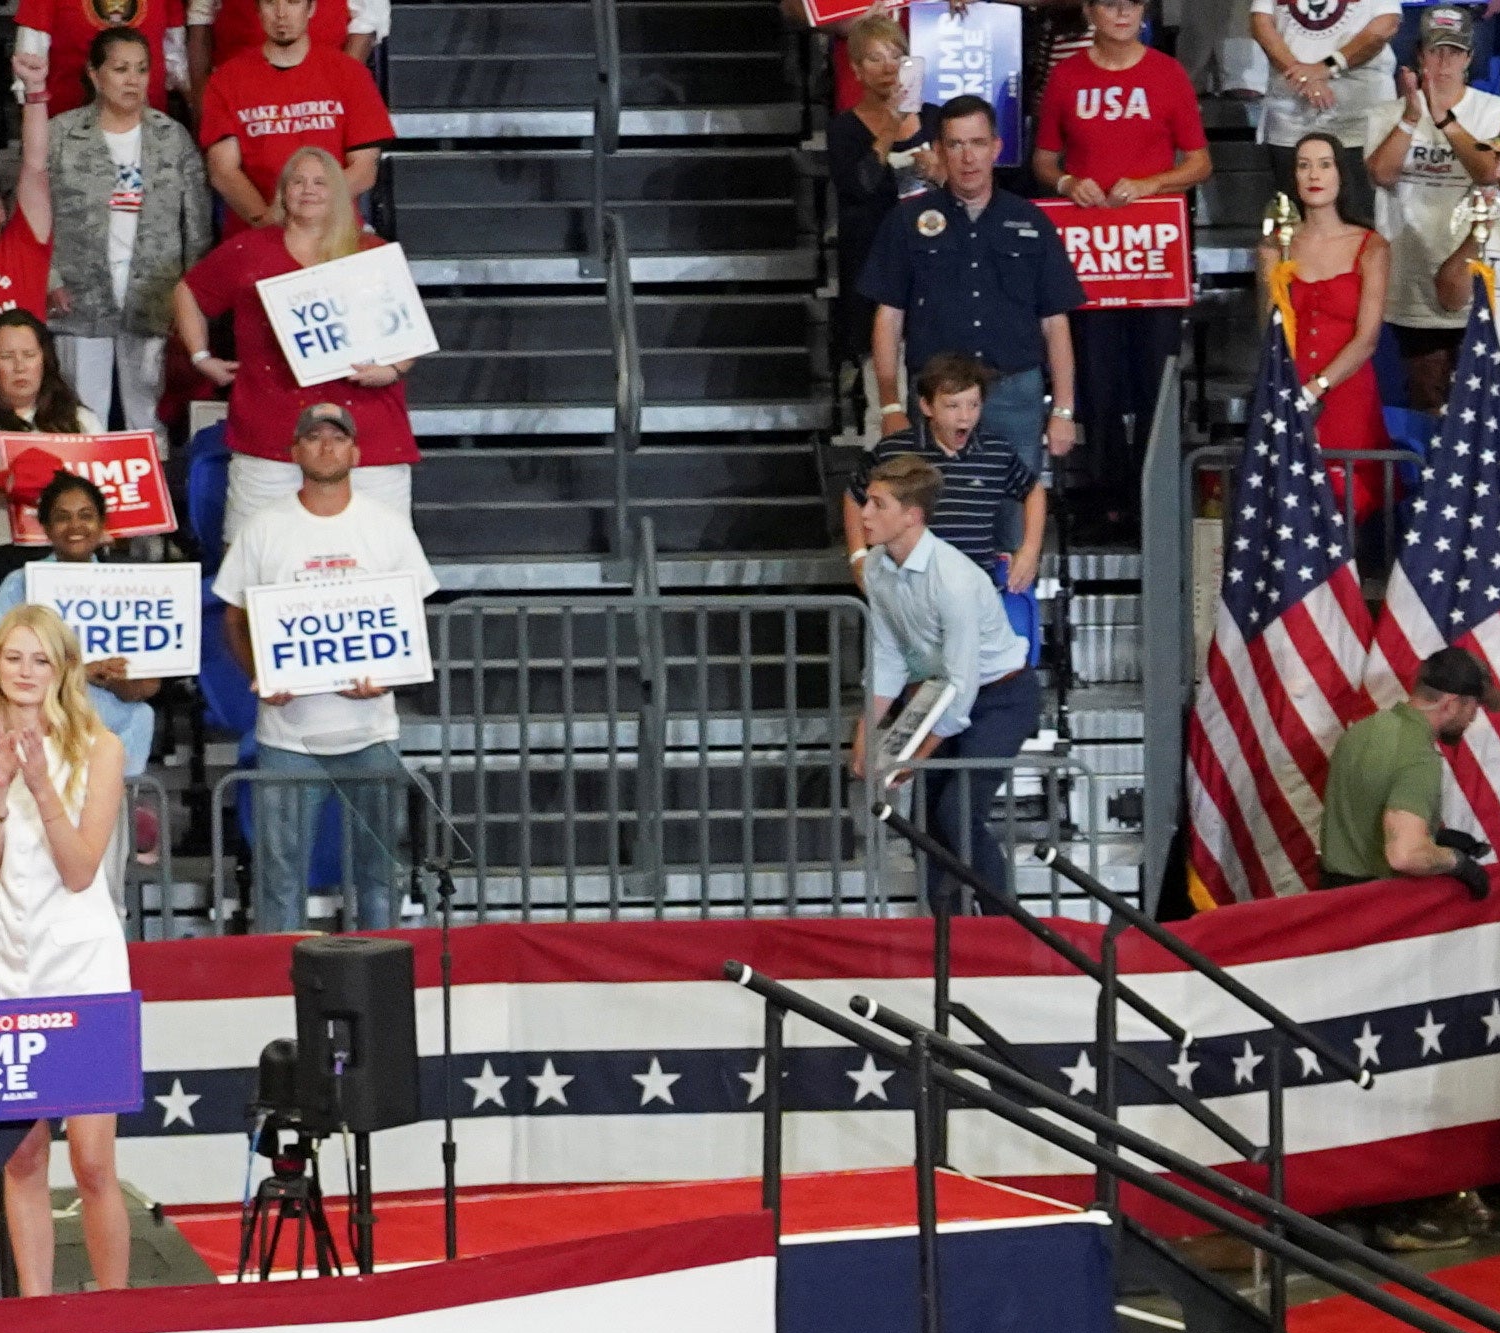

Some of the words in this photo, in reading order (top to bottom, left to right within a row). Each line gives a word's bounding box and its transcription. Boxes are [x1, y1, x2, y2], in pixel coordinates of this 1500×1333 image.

[938, 12, 966, 101] UMP
[238, 106, 280, 122] MAKE
[282, 100, 344, 118] AMERICA
[1077, 86, 1150, 121] USA
[246, 121, 291, 137] GREAT
[293, 115, 335, 132] AGAIN
[1056, 224, 1179, 250] RUMP
[1072, 250, 1165, 273] ANCE
[293, 304, 415, 359] FIRD!
[101, 585, 173, 595] KAMALA
[56, 600, 175, 622] YOU'RE
[321, 594, 393, 610] KAMALA
[279, 607, 396, 637] YOU'RE
[86, 623, 184, 655] RED!
[273, 631, 411, 671] FIRED!
[16, 1012, 73, 1030] 88022
[3, 1090, 38, 1102] AGAIN!
